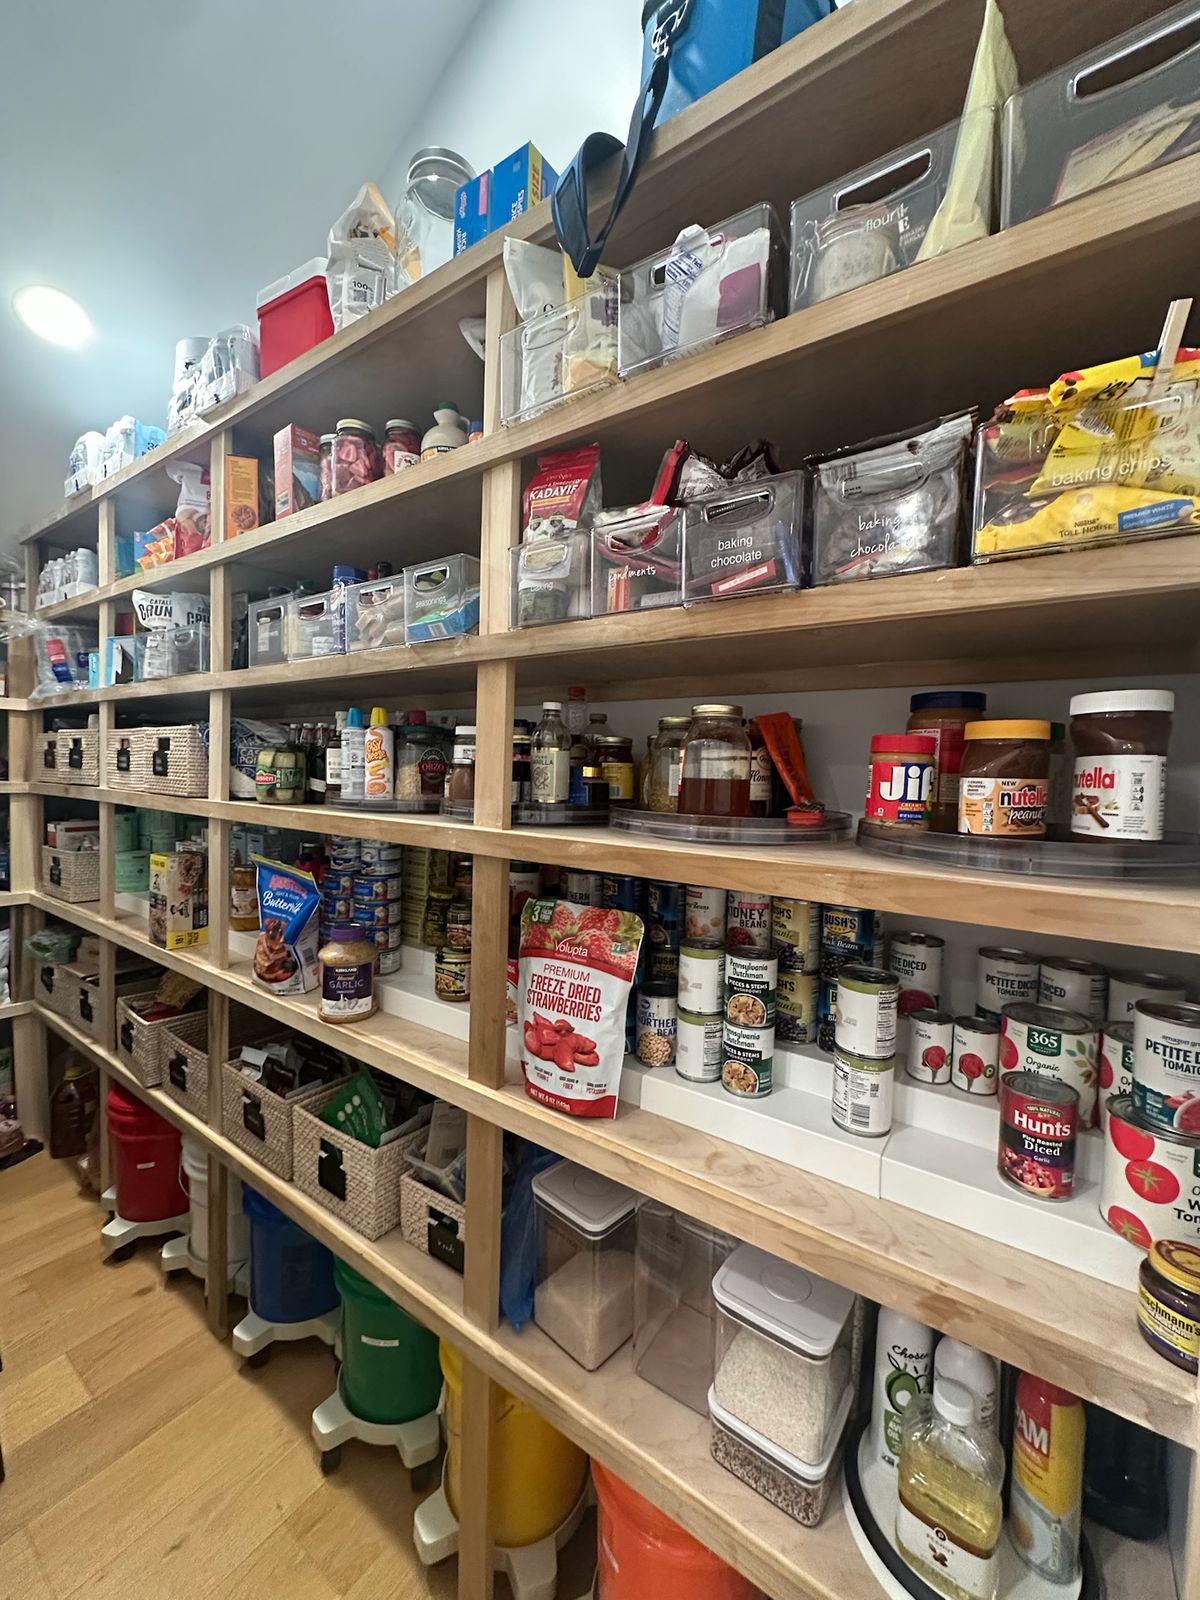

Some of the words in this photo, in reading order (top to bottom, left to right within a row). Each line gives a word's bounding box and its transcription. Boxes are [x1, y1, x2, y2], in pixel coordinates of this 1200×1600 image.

[531, 165, 541, 199] SIZE
[865, 206, 900, 232] flour
[1051, 466, 1113, 487] baking
[1119, 456, 1171, 476] chips
[530, 484, 578, 500] KADAYIF
[859, 512, 903, 533] baking
[718, 536, 753, 551] baking
[711, 550, 762, 568] chocolate
[138, 603, 172, 620] CRUN
[879, 766, 934, 801] Jif
[532, 905, 540, 921] 3
[824, 913, 857, 930] BUSH'S
[740, 919, 767, 929] BEANS
[555, 936, 588, 957] Volupta
[837, 940, 859, 951] Beans
[543, 963, 590, 982] PREMIUM
[903, 961, 927, 972] DICED
[329, 979, 364, 990] GARLIC
[531, 974, 566, 996] FREEZE
[568, 982, 601, 1004] DRIED
[986, 974, 1015, 989] PETITE
[527, 989, 602, 1022] STRAWBERRIES
[1030, 1031, 1058, 1049] 365
[1162, 1034, 1189, 1046] amazon
[1145, 1038, 1191, 1064] PETITE
[1025, 1056, 1060, 1073] Organic
[1039, 1106, 1061, 1117] NATURAL
[1023, 1139, 1061, 1156] Diced
